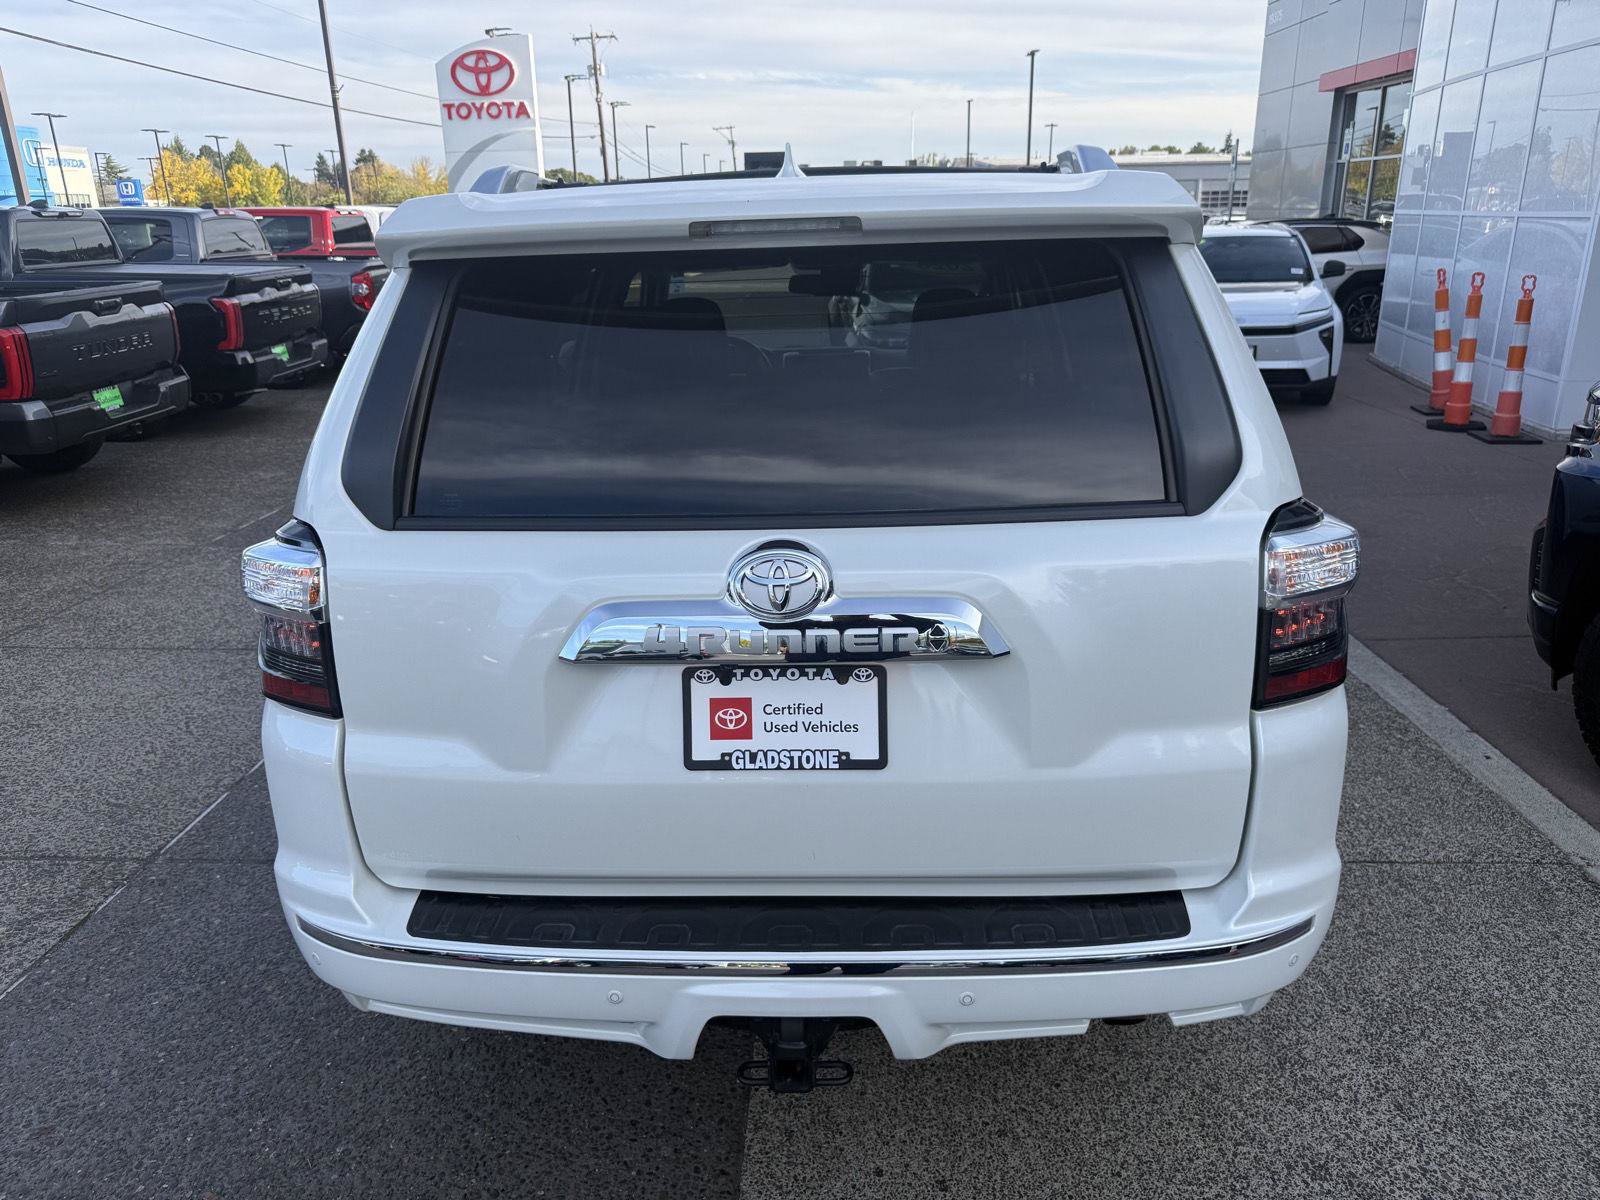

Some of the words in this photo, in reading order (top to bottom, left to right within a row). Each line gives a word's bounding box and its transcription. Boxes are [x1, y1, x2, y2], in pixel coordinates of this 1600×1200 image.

[442, 101, 531, 120] TOYOTA
[46, 157, 86, 168] HONDA
[72, 331, 153, 361] TUNDRA
[734, 668, 836, 681] TOYOTA
[763, 703, 824, 716] Certified
[763, 721, 798, 733] Used
[802, 721, 859, 733] Vehicles
[732, 750, 840, 770] GLADSTONE
